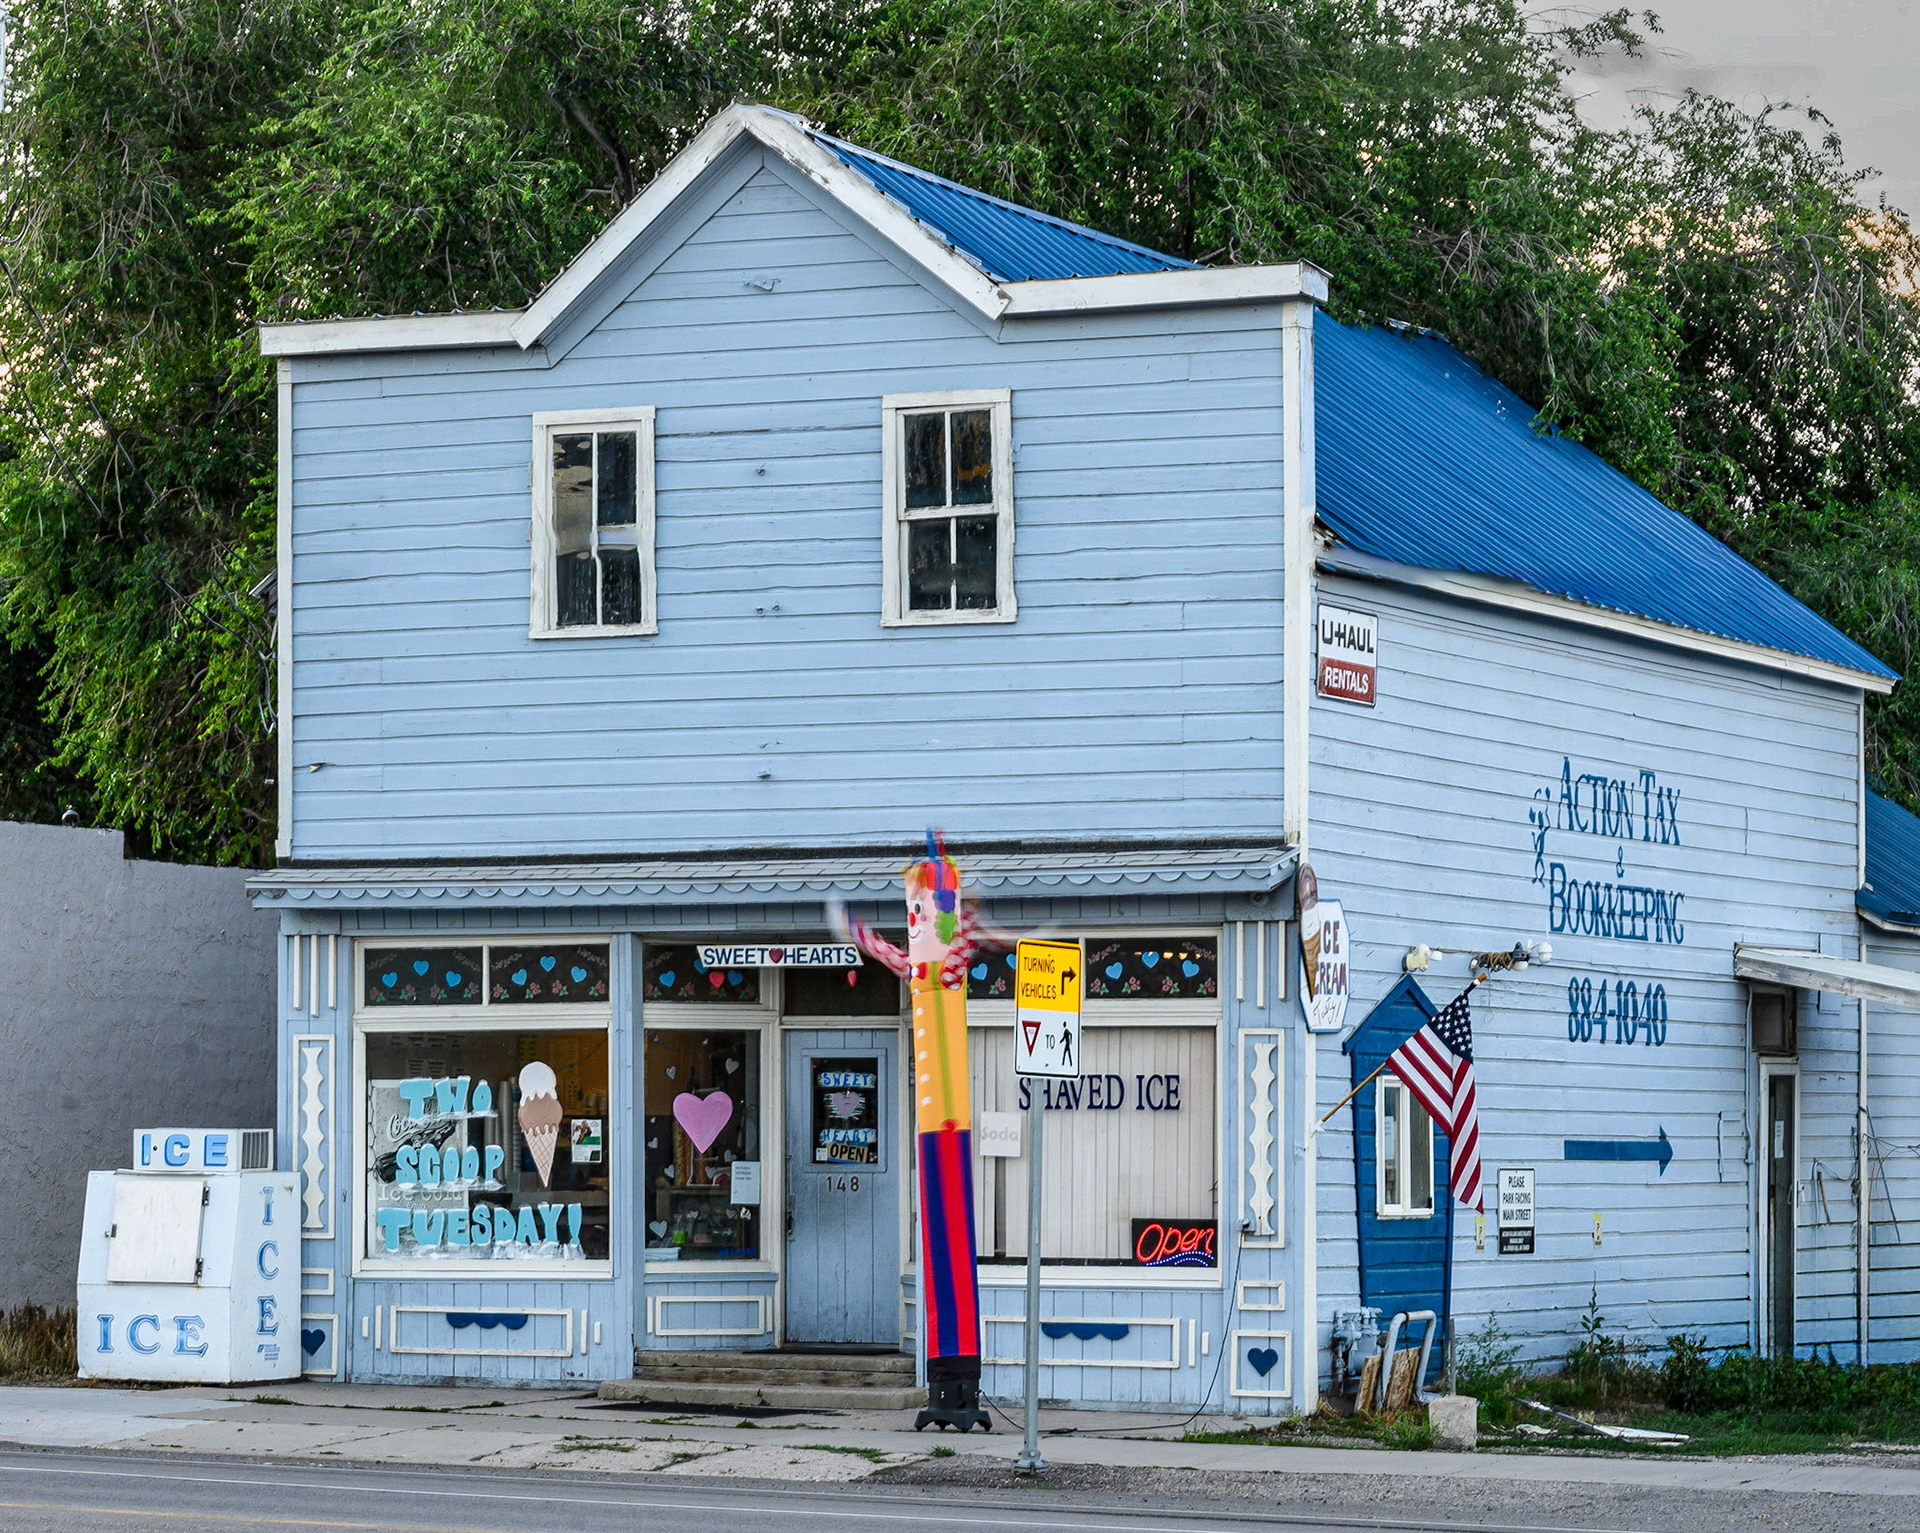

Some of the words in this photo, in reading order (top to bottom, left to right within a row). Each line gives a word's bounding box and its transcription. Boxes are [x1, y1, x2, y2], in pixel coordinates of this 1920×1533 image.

[1322, 619, 1374, 654] U-HAUL
[1325, 666, 1369, 694] RENTALS
[703, 947, 766, 965] SWEET
[783, 947, 857, 965] HEARTS
[1023, 956, 1056, 975] TURNING
[1020, 982, 1057, 1000] VEHICLES
[1567, 976, 1668, 1047] 884-1040
[1045, 1034, 1056, 1050] TO
[822, 1072, 872, 1087] SWEET
[399, 1076, 493, 1119] TWO
[1135, 1074, 1181, 1111] ICE
[981, 1126, 1020, 1142] Soda
[141, 1133, 229, 1167] ICE
[830, 1143, 865, 1162] OPEN
[395, 1143, 505, 1190] SCOOP
[826, 1176, 860, 1192] 148
[1508, 1175, 1526, 1188] PLEASE
[1502, 1192, 1514, 1205] PARK
[1515, 1192, 1532, 1205] FACING
[1502, 1208, 1514, 1221] MAIN
[1515, 1208, 1532, 1221] STREET
[377, 1202, 584, 1253] TUESDAY!
[1135, 1223, 1215, 1263] Open
[256, 1185, 281, 1337] ICE
[96, 1313, 209, 1358] ICE
